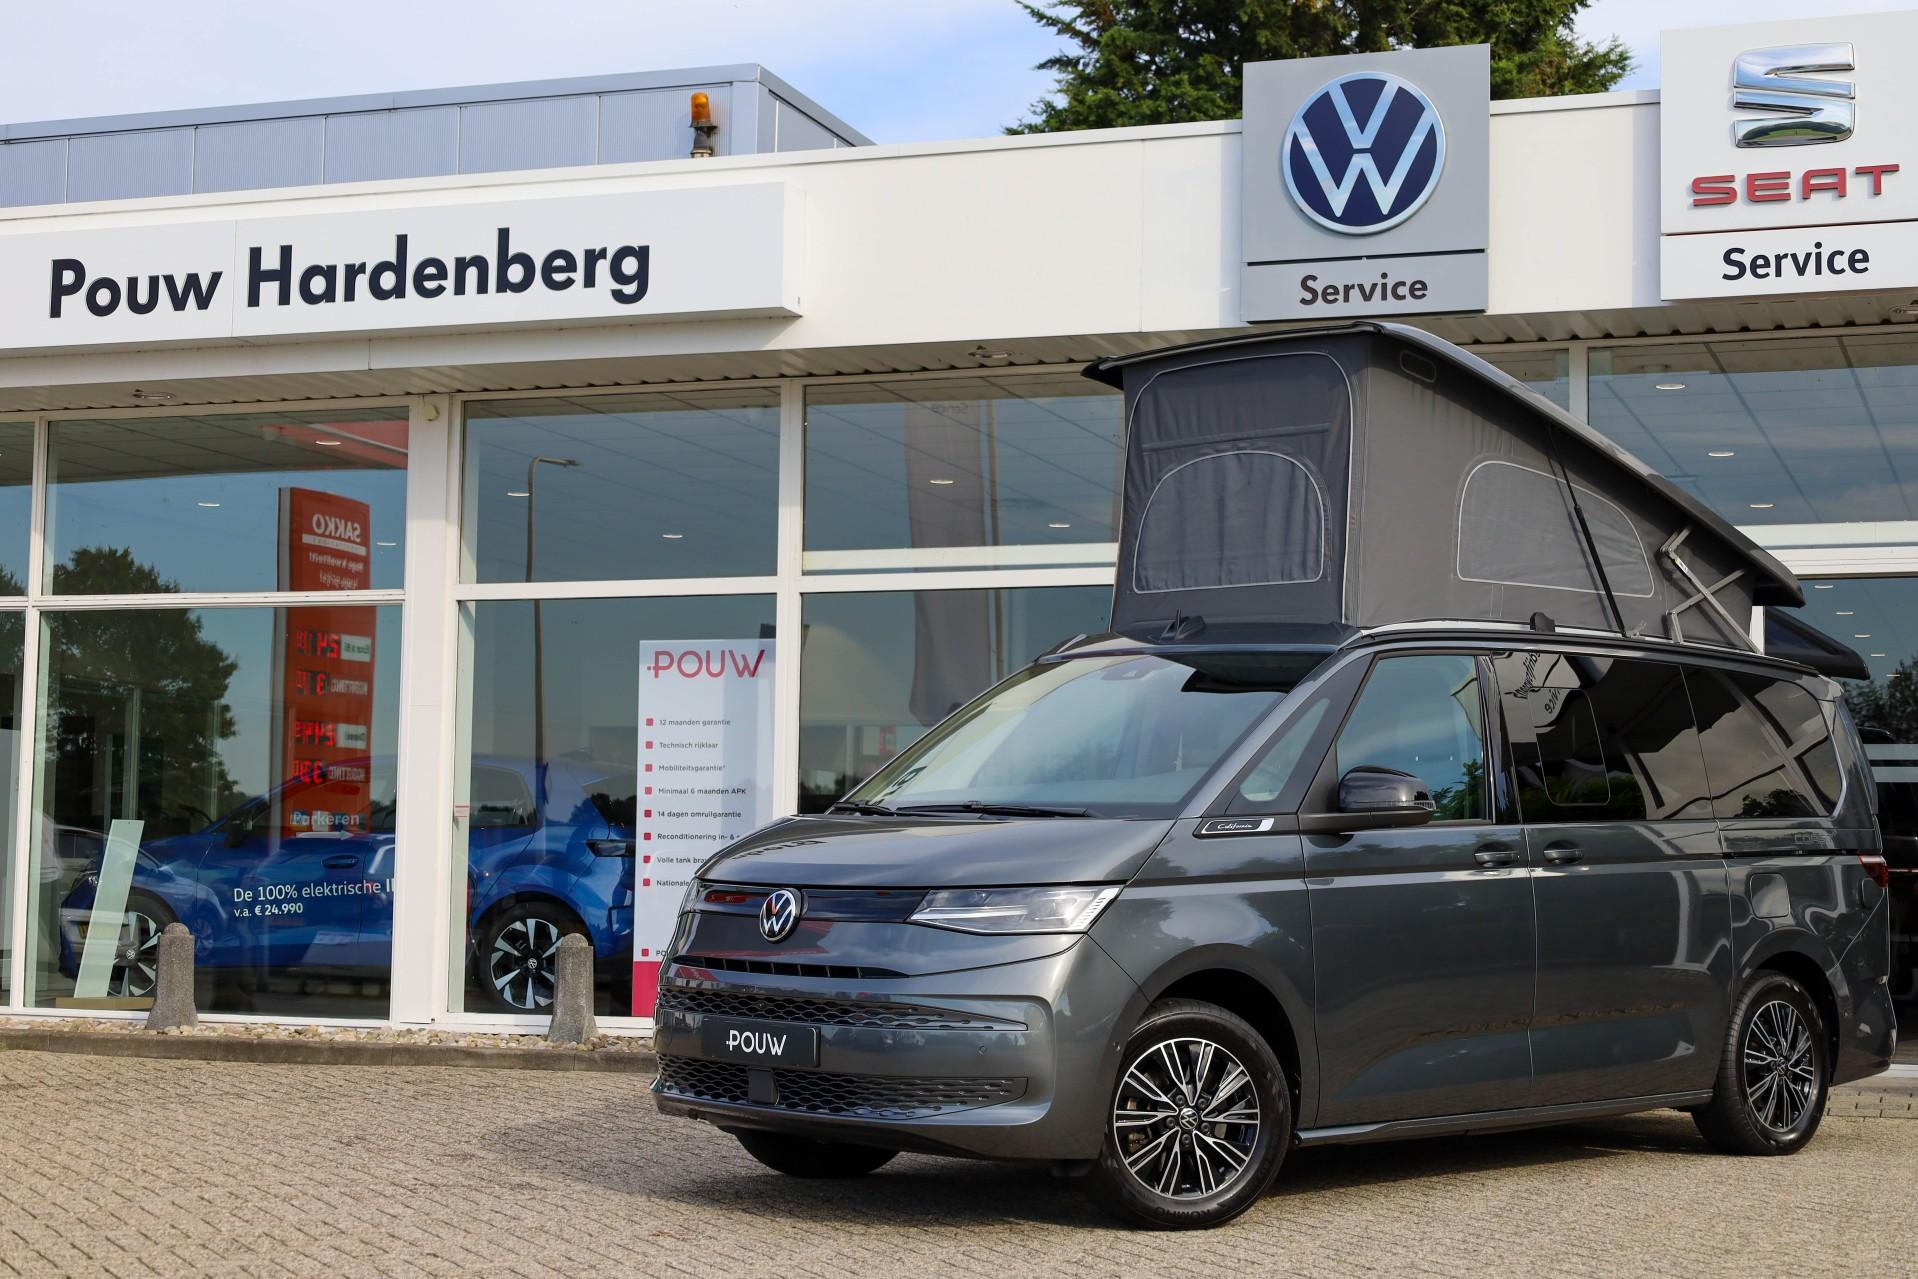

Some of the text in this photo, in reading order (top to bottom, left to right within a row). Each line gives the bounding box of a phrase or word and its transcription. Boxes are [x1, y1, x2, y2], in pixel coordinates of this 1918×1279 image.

[1691, 163, 1900, 207] SEAT
[1721, 241, 1871, 281] Service
[49, 227, 651, 319] Pouw Hardenberg
[1299, 272, 1429, 306] Service
[647, 650, 765, 679] POUW
[702, 719, 731, 728] garantie
[660, 740, 718, 751] Technisch rijklaar
[730, 787, 746, 795] APK
[292, 812, 360, 826] Parkeren
[667, 811, 689, 820] dagen
[690, 810, 742, 820] omruilgarantie
[1217, 822, 1253, 830] California
[657, 833, 717, 842] Reconditionering
[676, 856, 692, 864] tank
[234, 888, 253, 902] De
[257, 885, 298, 901] 100%
[302, 880, 381, 897] elektrische
[233, 907, 252, 918] v.a.
[264, 902, 304, 916] 24.990
[726, 1029, 787, 1056] POUW
